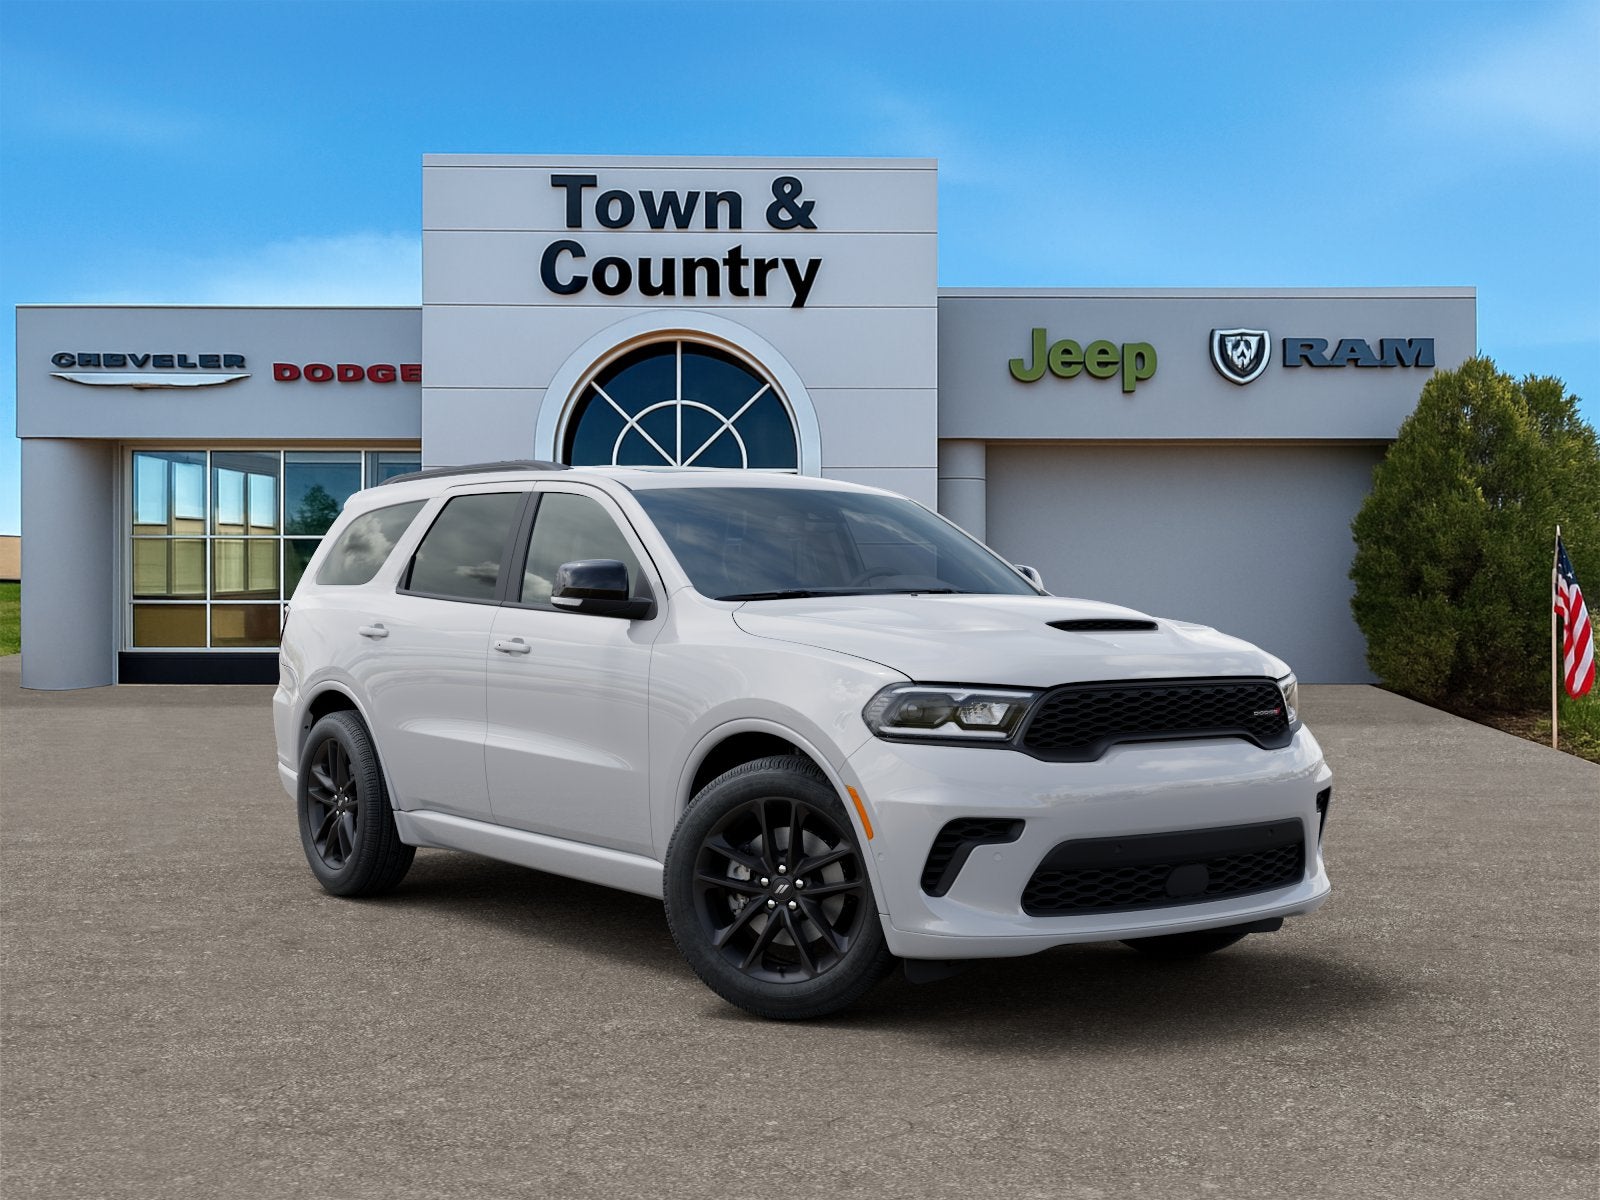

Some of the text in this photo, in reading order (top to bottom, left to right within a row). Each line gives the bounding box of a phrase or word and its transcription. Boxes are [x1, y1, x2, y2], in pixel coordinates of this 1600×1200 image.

[550, 174, 818, 230] Town &
[540, 239, 822, 308] Country
[273, 363, 422, 382] DODGE
[1009, 328, 1157, 393] Jeep
[1282, 338, 1435, 368] RAM
